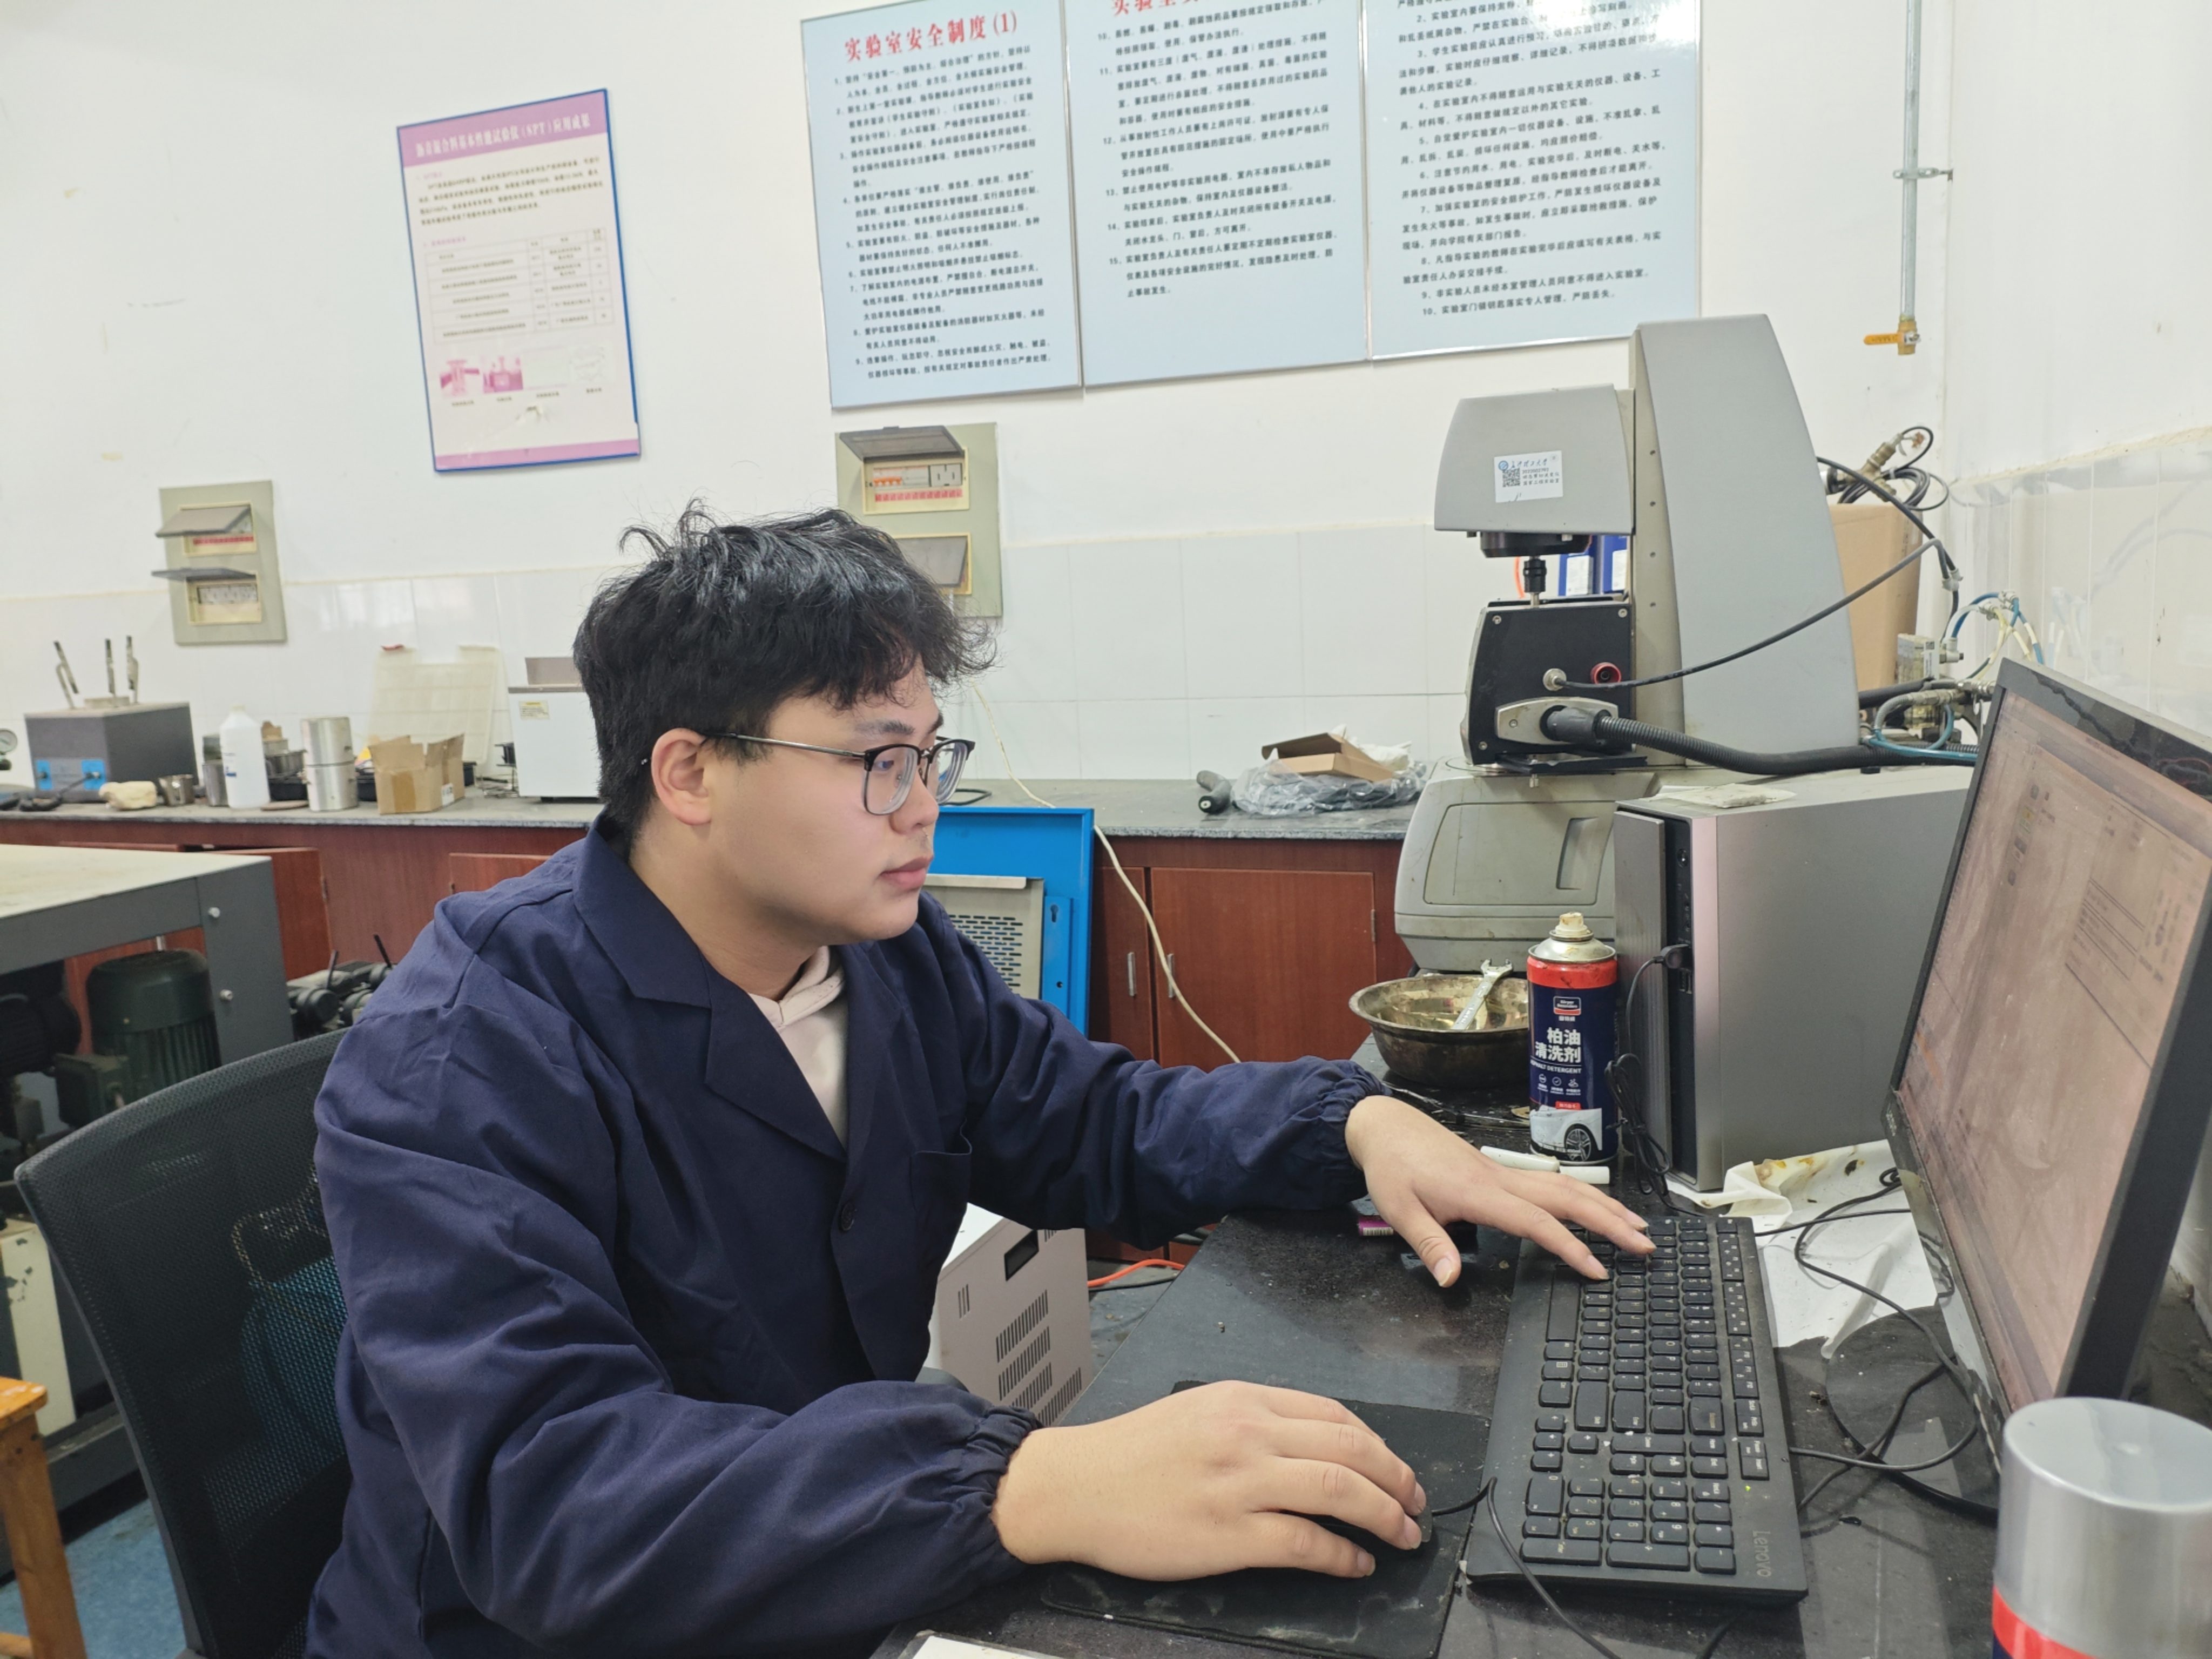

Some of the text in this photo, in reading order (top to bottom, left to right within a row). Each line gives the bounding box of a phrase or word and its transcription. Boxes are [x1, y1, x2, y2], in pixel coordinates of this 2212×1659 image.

[1547, 1027, 1581, 1046] 柏油
[1535, 1041, 1582, 1063] 清洗剂
[1752, 1530, 1772, 1577] Lenovo
